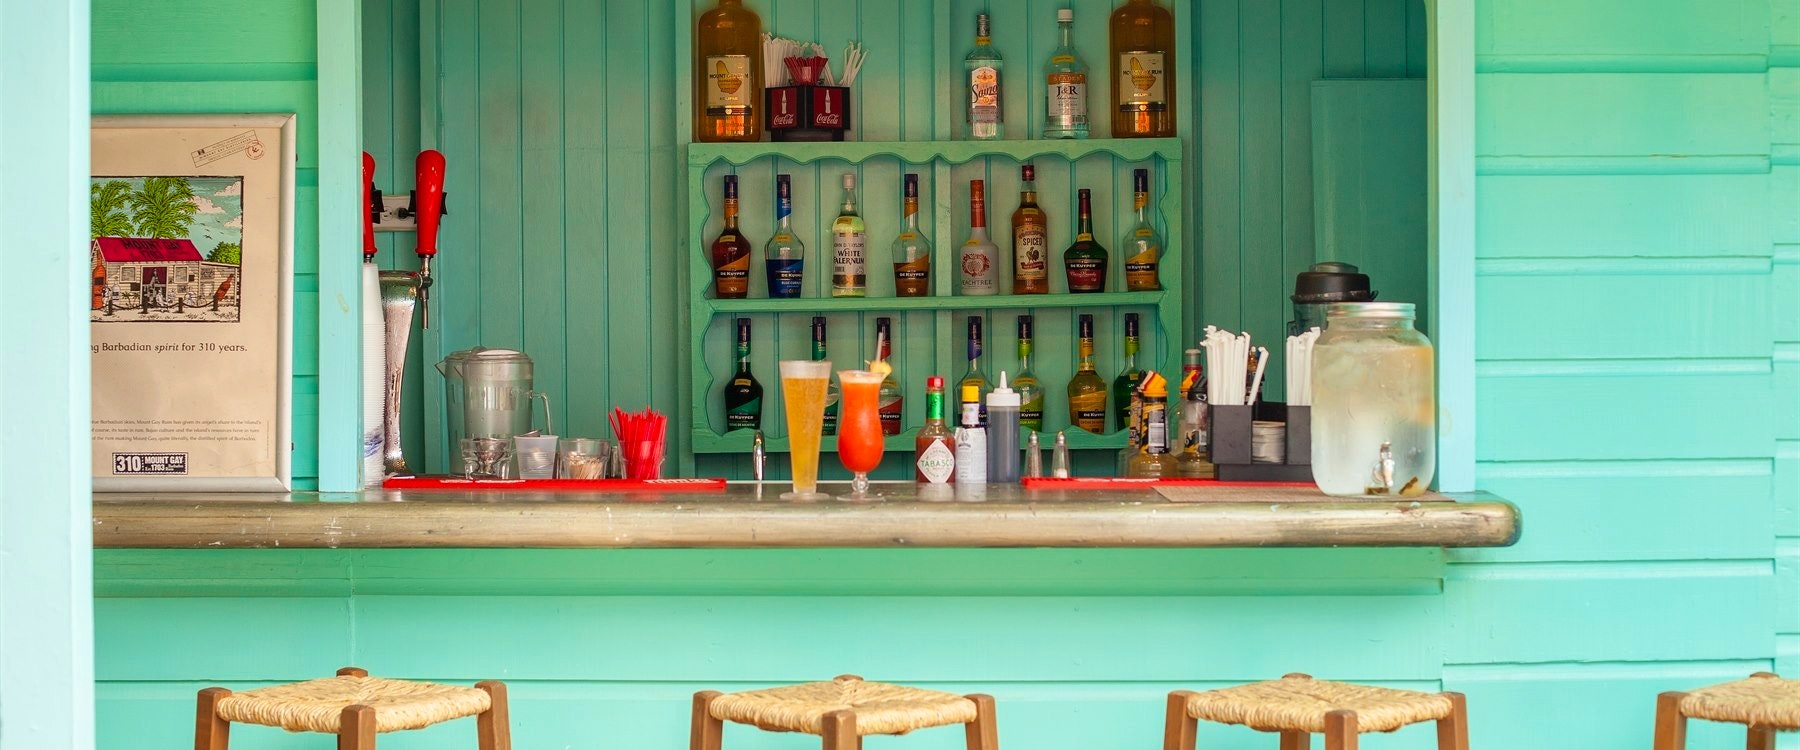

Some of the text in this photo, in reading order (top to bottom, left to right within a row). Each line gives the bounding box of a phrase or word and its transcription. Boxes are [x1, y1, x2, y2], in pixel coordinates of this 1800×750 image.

[838, 249, 861, 257] WHITE
[102, 343, 152, 351] Barbadian
[155, 343, 179, 354] spirit
[181, 343, 196, 351] for
[199, 343, 216, 351] 310
[219, 345, 248, 354] years.
[116, 456, 142, 472] 310
[145, 456, 184, 464] MOUNT GAY
